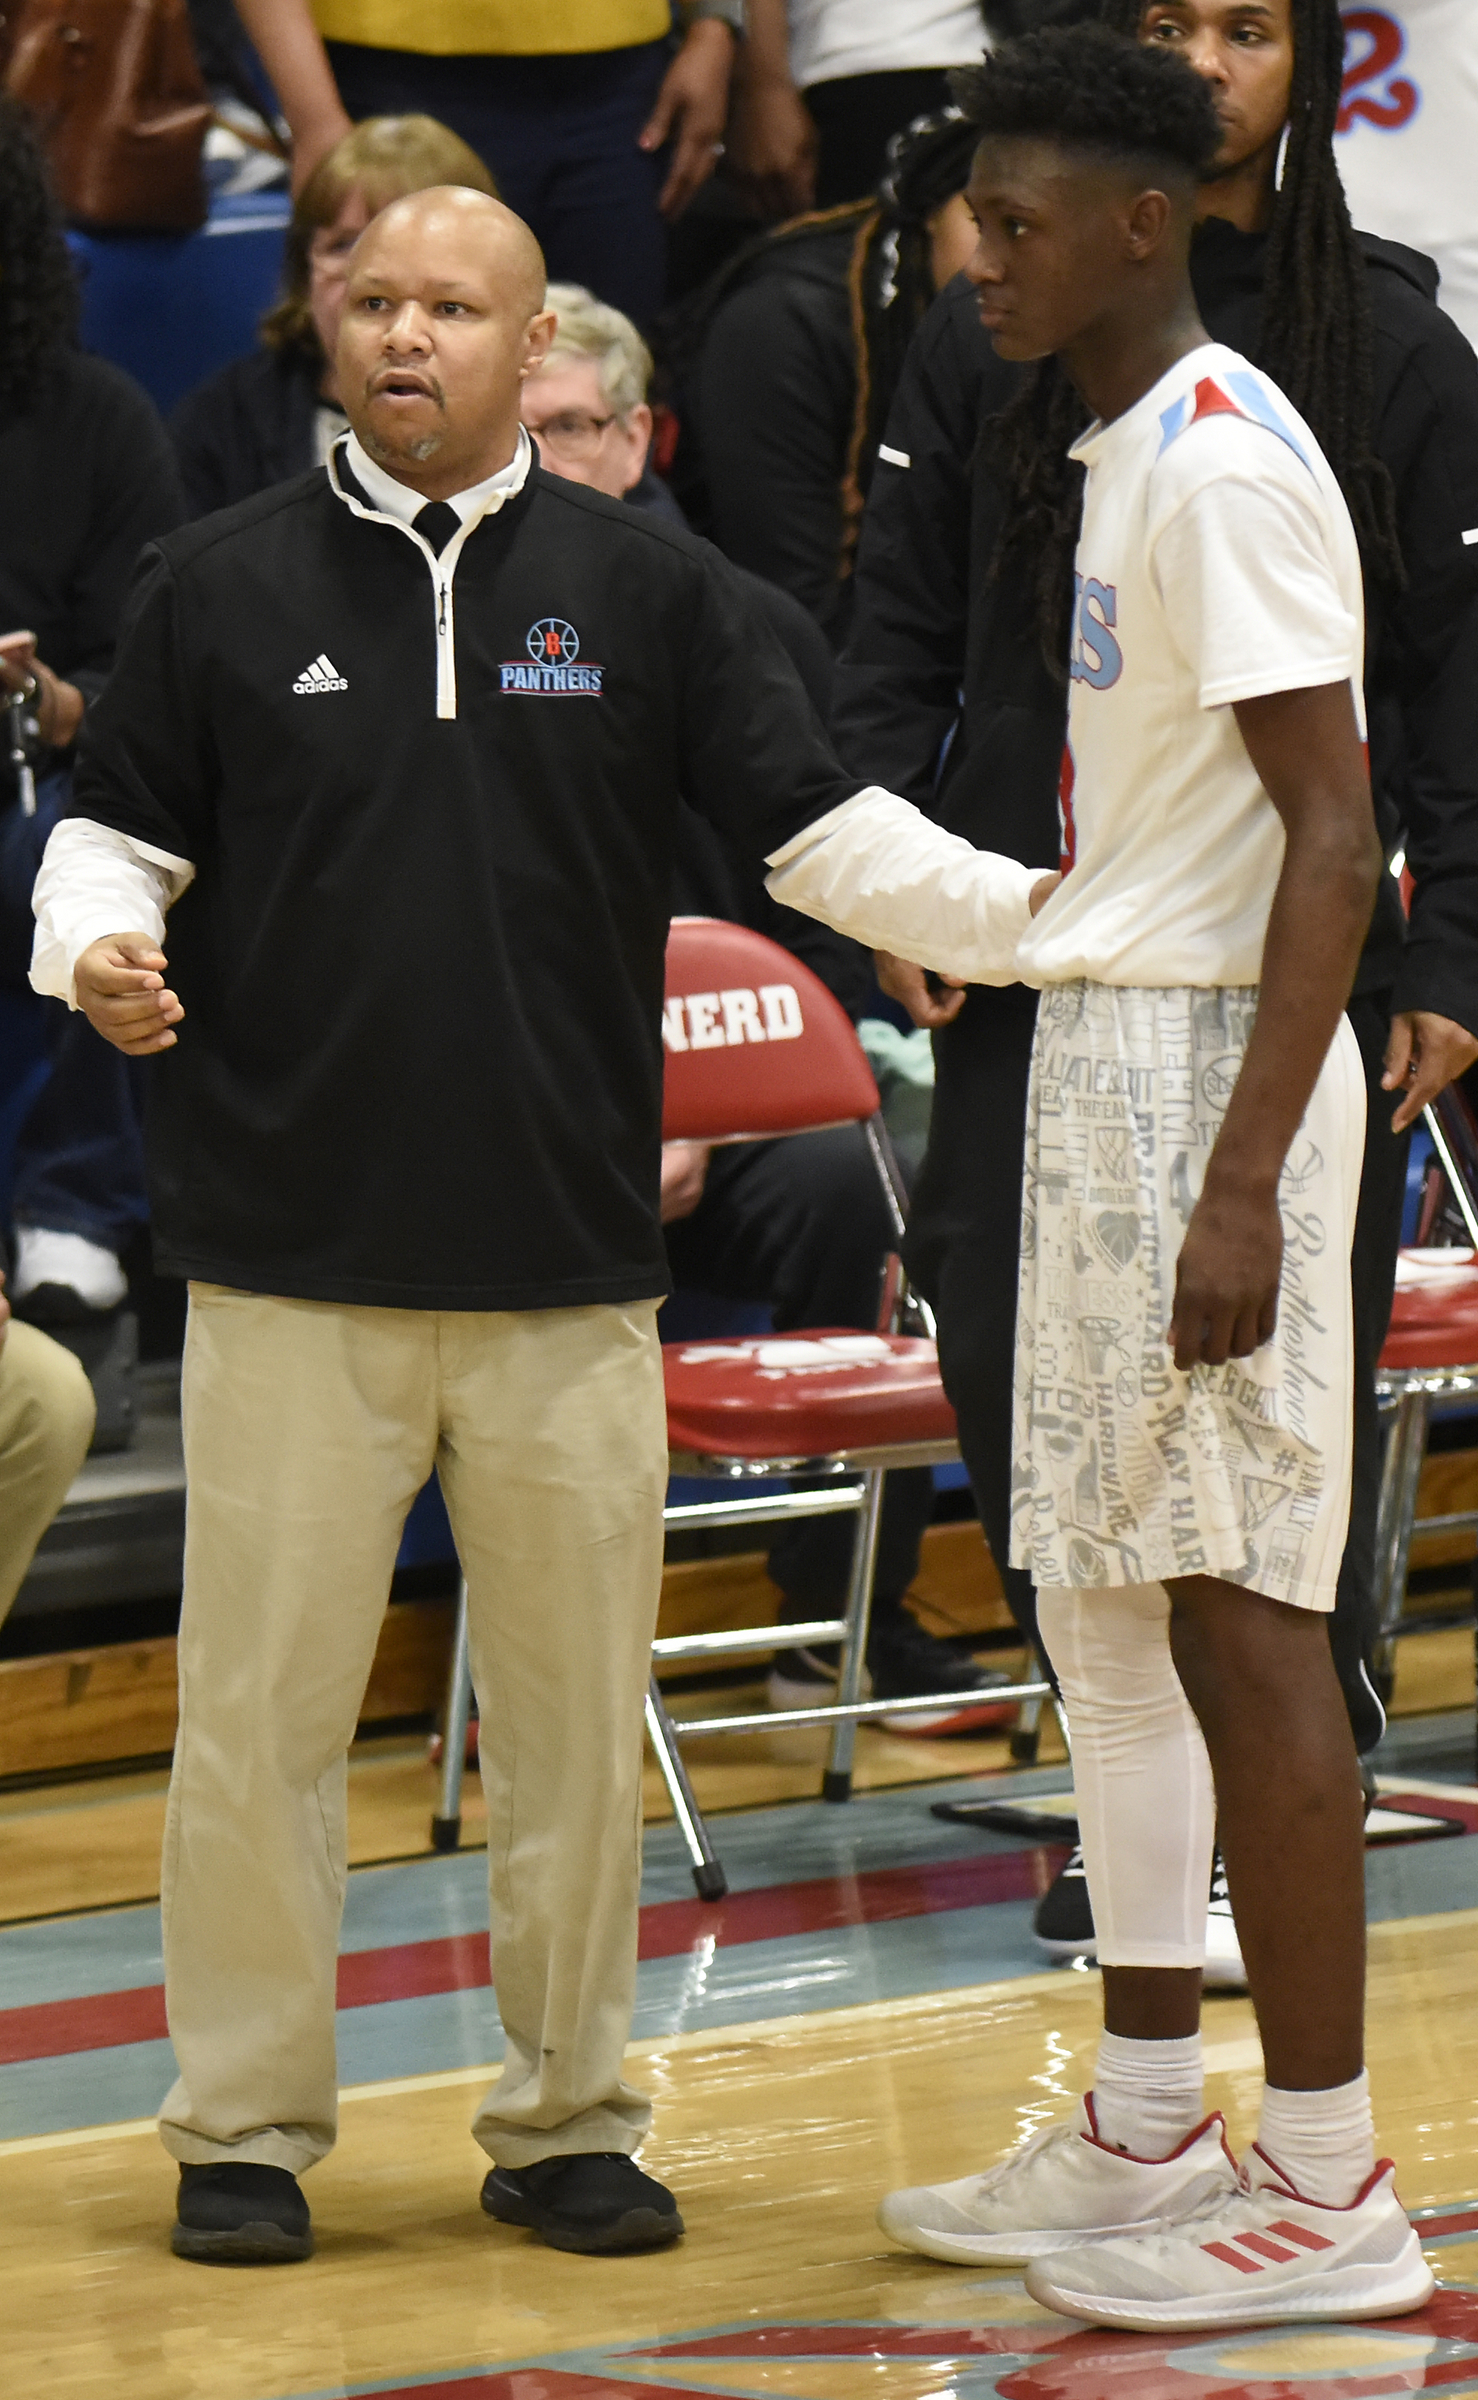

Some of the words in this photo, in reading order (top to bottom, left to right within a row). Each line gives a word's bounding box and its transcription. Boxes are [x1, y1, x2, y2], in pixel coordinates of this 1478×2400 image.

[545, 632, 561, 656] B
[1070, 571, 1123, 691] S
[293, 677, 348, 695] adidas
[501, 666, 602, 692] PANTHERS
[1279, 1197, 1330, 1457] Brotherhood
[1095, 1381, 1139, 1538] HARDWARE
[1146, 1403, 1191, 1487] PLAY
[1287, 1458, 1327, 1533] FAMILY
